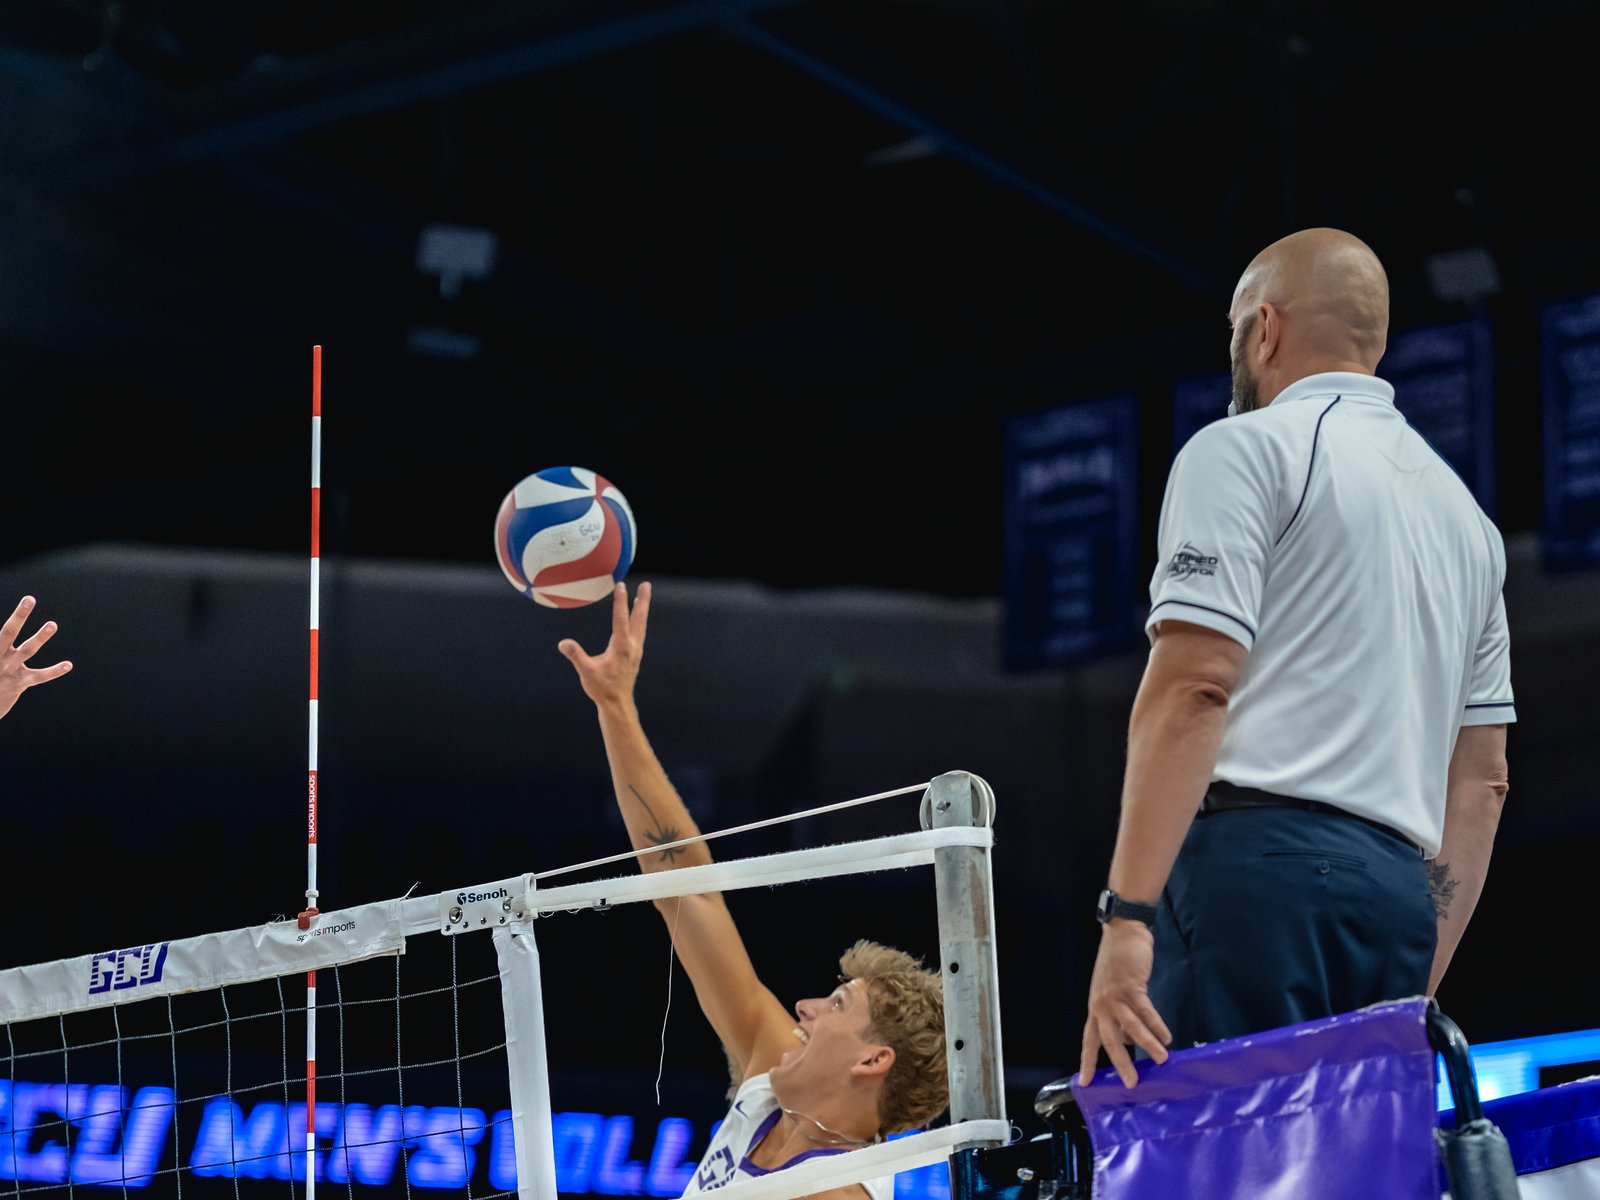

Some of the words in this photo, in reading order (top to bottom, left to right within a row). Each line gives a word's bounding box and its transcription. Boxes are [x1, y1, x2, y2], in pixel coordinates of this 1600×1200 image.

[467, 887, 508, 903] Senoh
[322, 920, 356, 935] imports
[88, 942, 170, 995] GCU
[0, 1078, 176, 1188] CU
[190, 1096, 487, 1190] MEN'S
